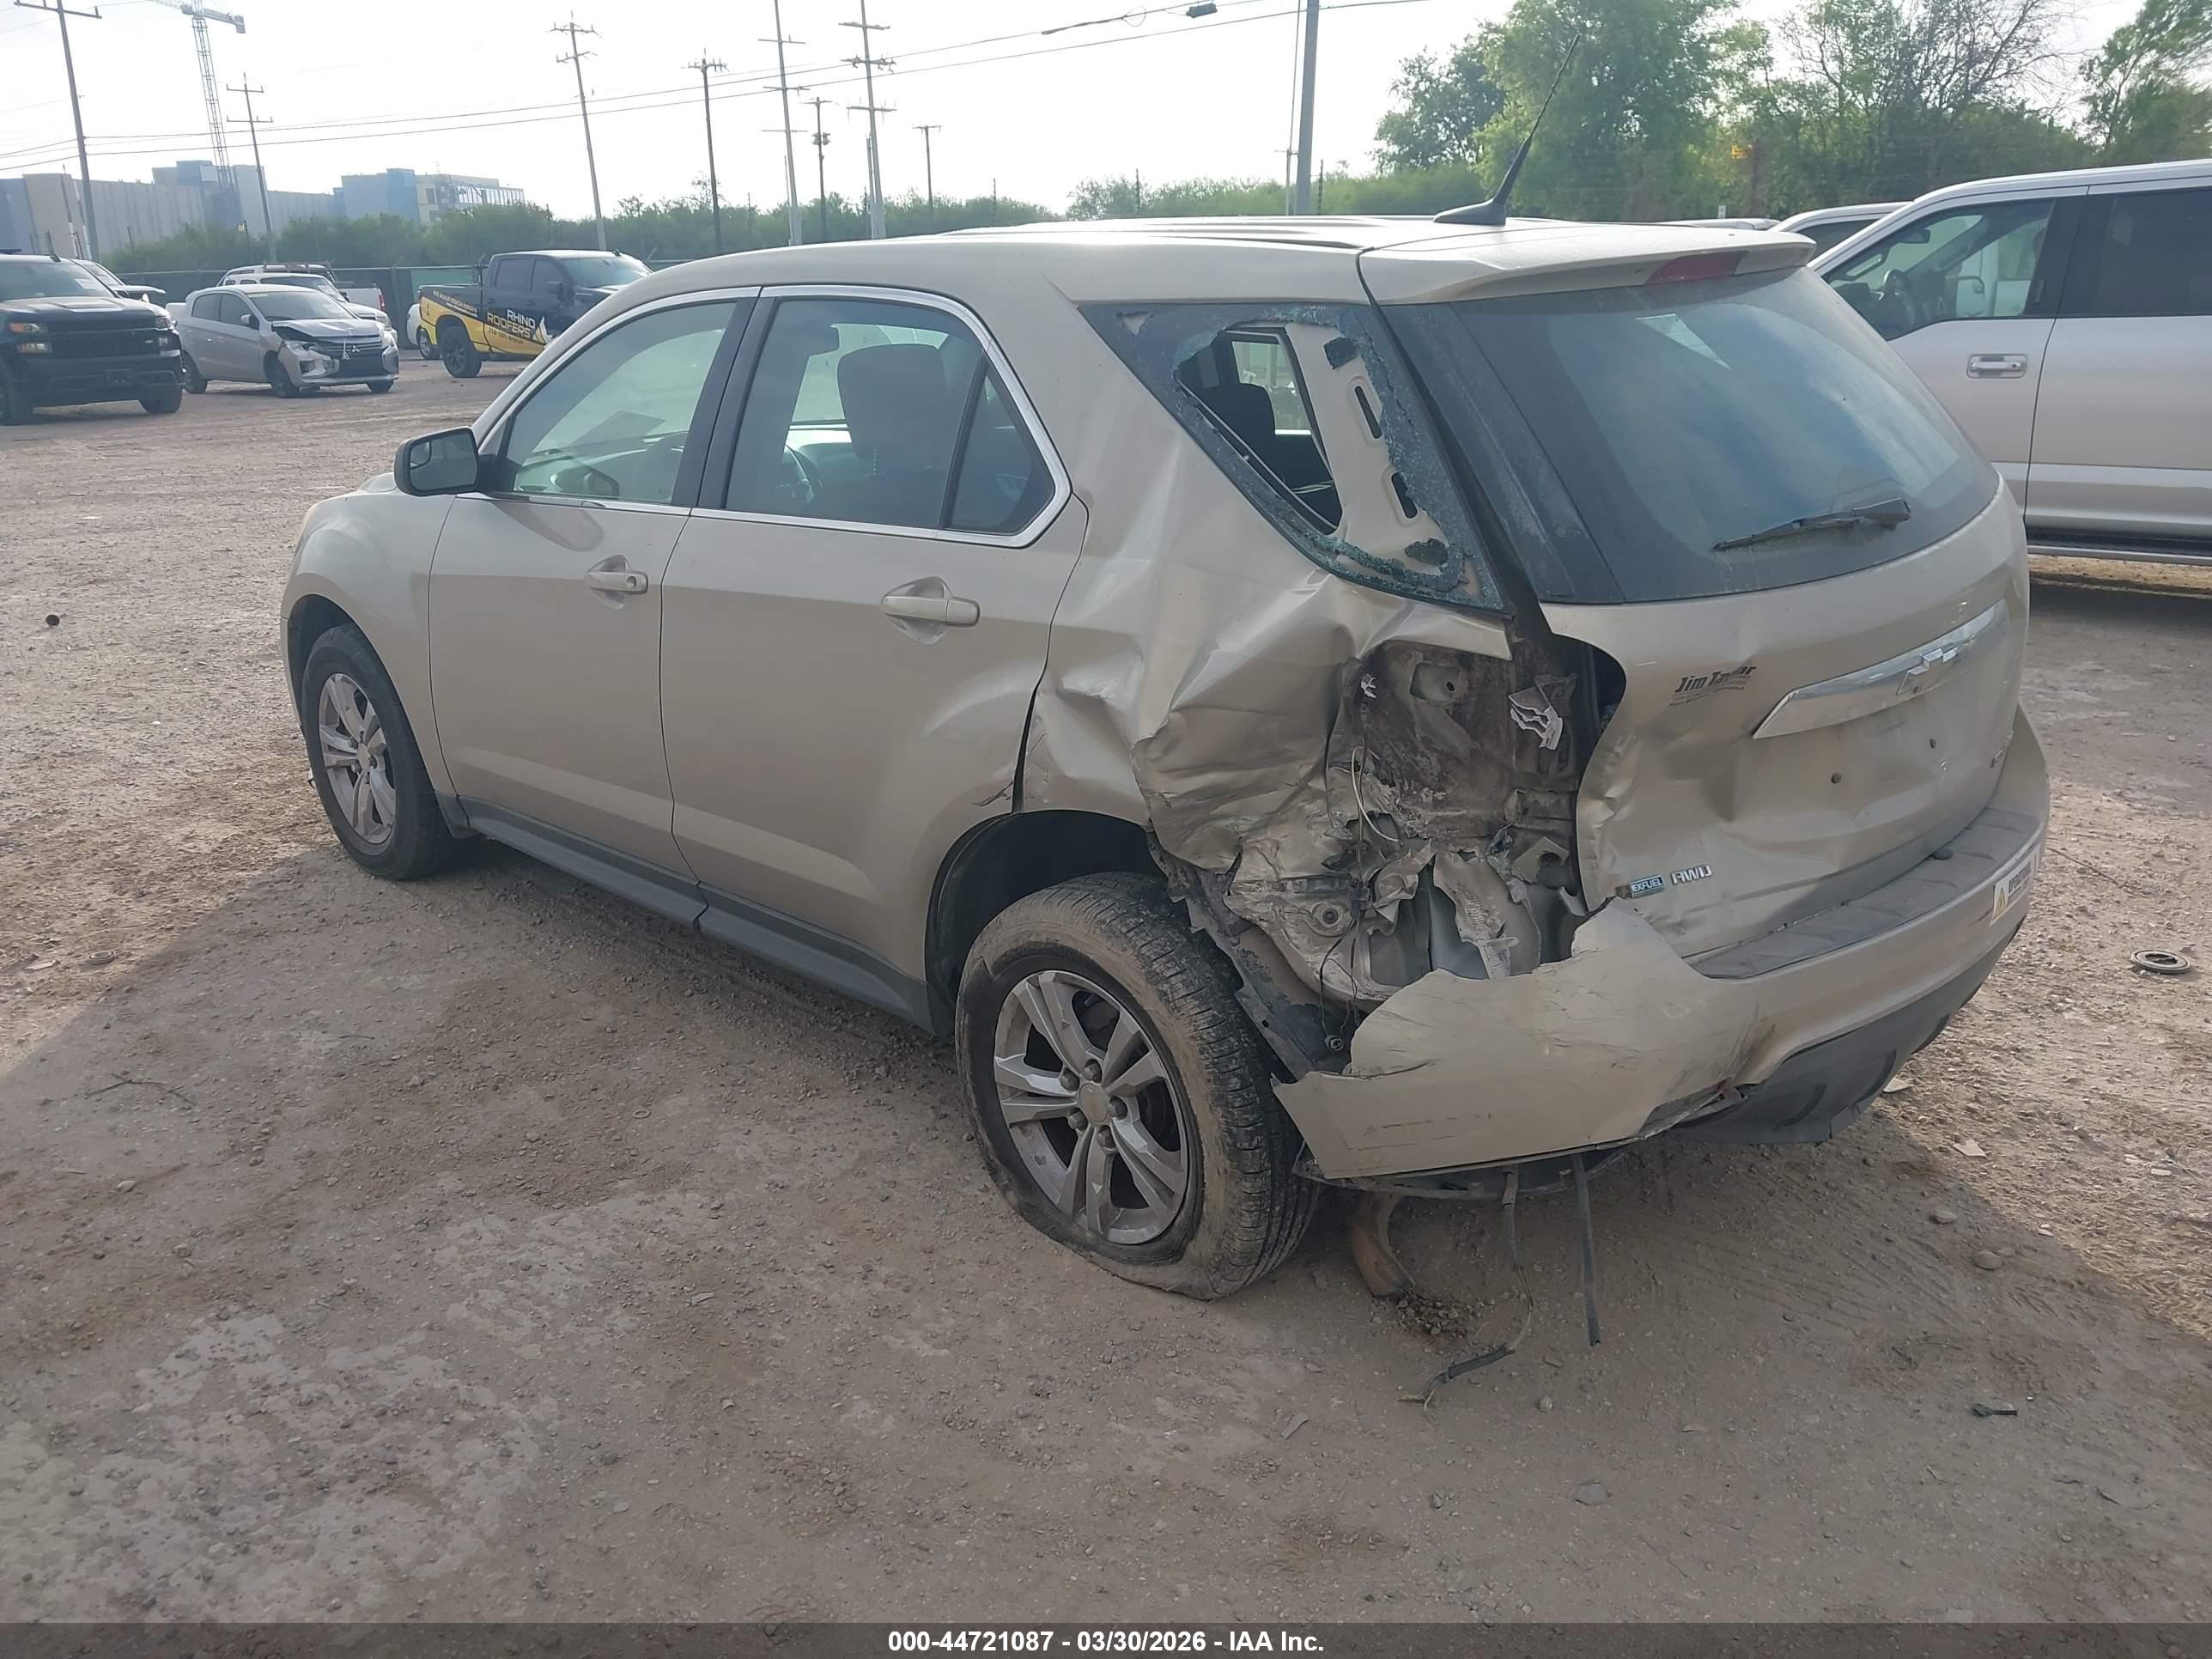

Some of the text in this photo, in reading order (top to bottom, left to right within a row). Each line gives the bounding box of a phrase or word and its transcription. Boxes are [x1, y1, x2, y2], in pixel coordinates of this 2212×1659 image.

[487, 312, 531, 338] ROOFERS
[507, 309, 536, 329] RHINO
[1674, 675, 1708, 693] Jim
[1671, 866, 1712, 885] AWD
